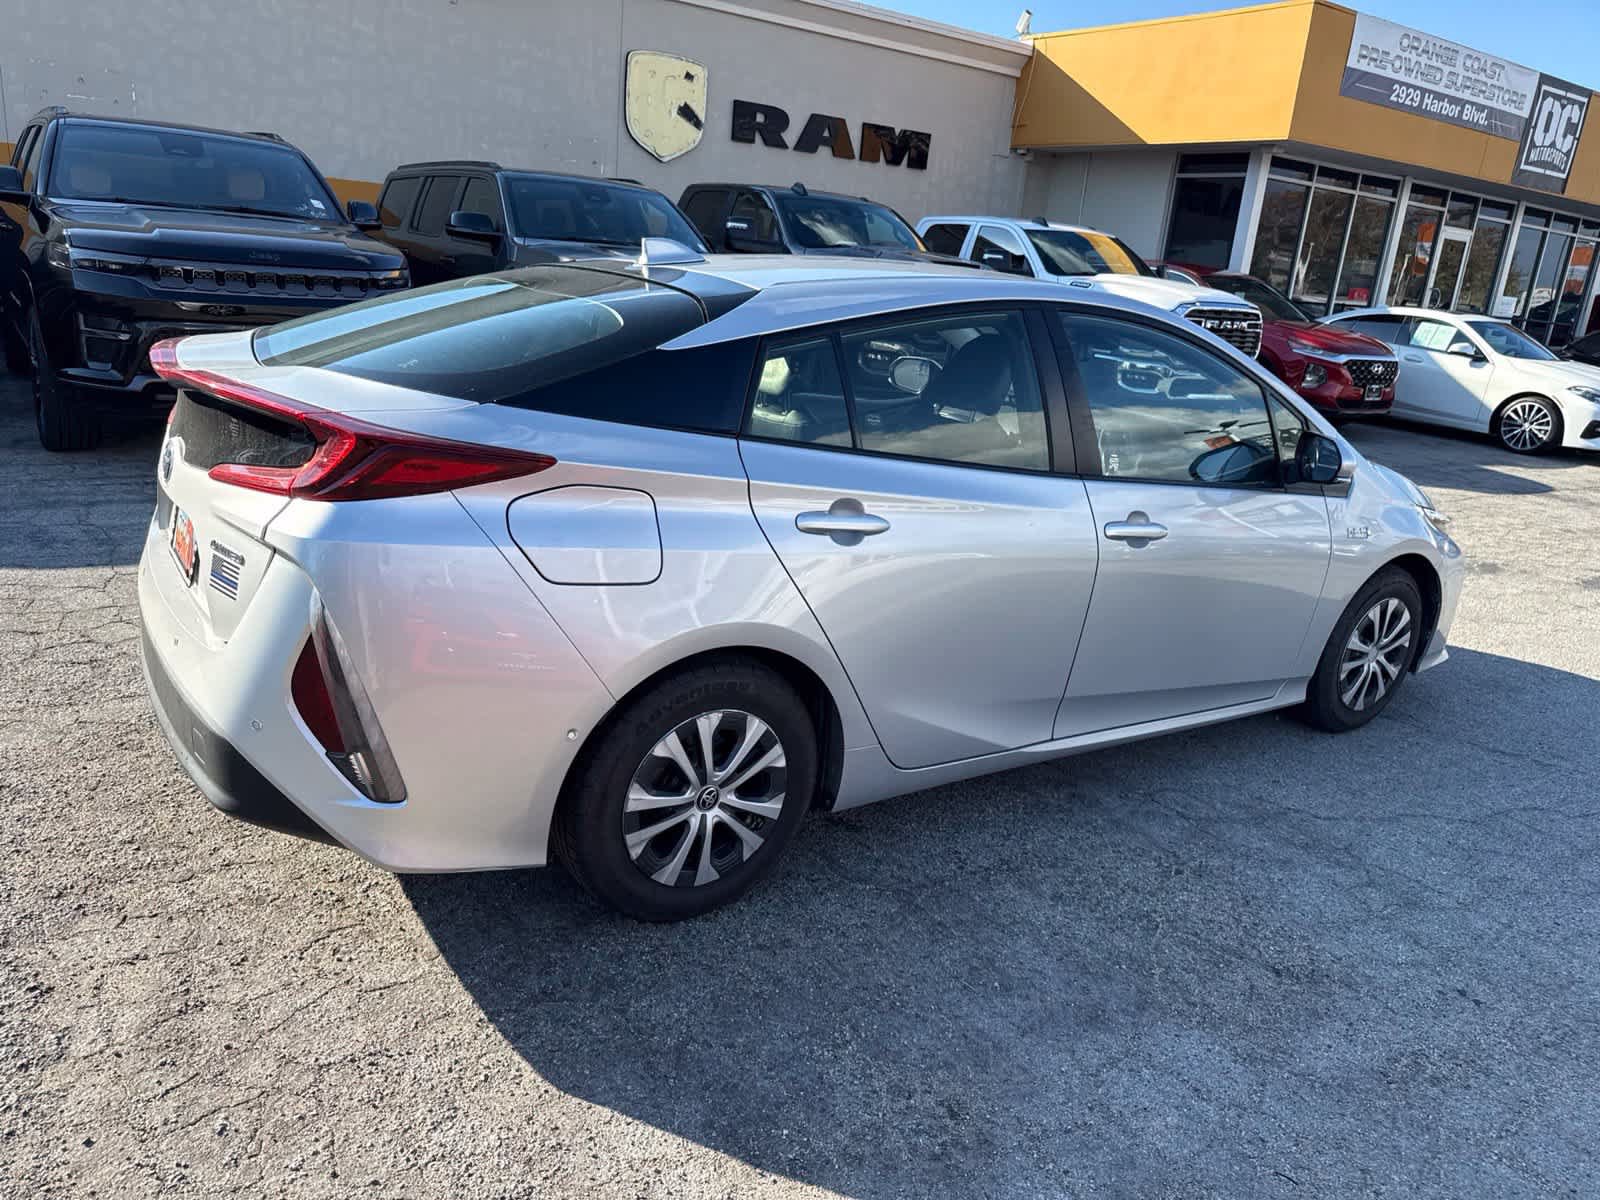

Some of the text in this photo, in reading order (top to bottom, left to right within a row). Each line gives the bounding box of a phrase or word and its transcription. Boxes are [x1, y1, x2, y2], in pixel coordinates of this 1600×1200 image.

[1356, 43, 1528, 112] PRE-OWNED SUPERSTORE
[1399, 32, 1506, 82] ORANGE COAST
[1389, 84, 1489, 126] 2929 Harbor Blvd.
[1533, 96, 1581, 153] OC
[731, 99, 932, 170] RAM
[1528, 146, 1568, 172] MOTORSPORTS
[1205, 320, 1248, 330] RAM
